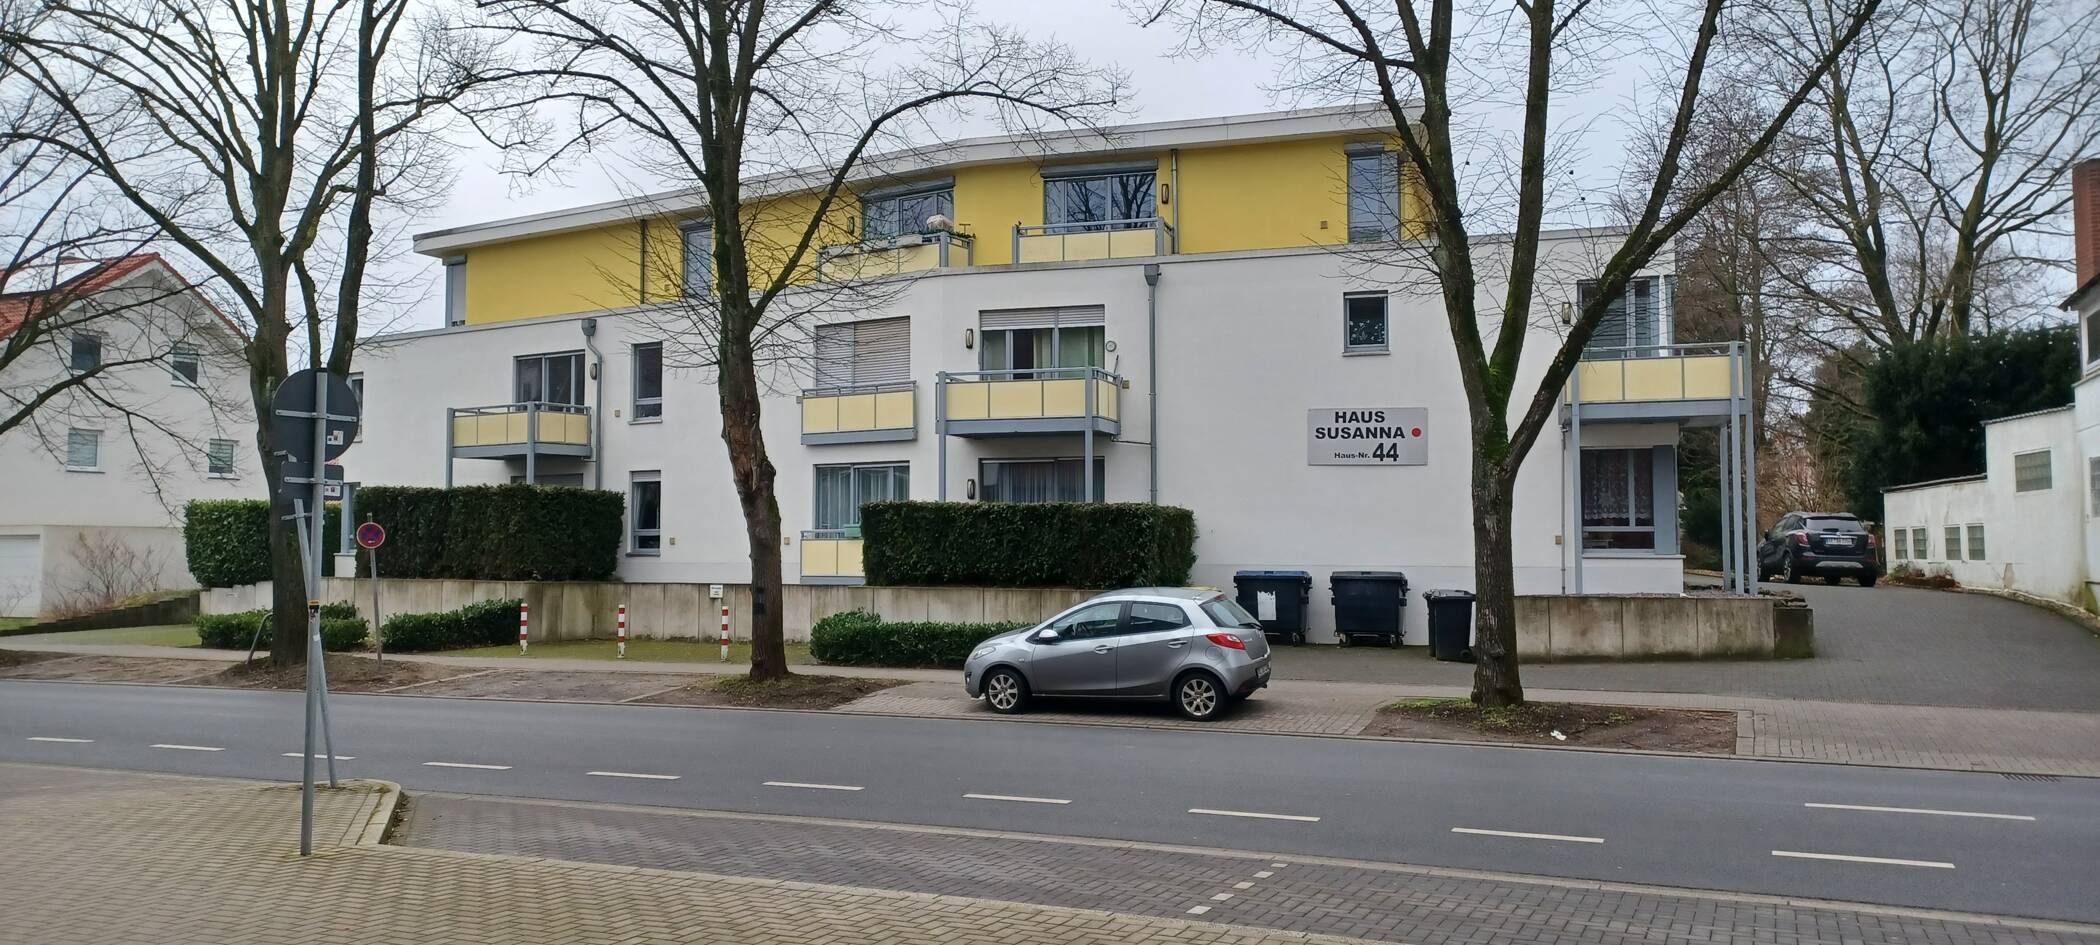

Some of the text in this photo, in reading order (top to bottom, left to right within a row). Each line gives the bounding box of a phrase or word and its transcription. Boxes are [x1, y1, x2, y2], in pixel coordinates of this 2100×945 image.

[1335, 411, 1386, 423] HAUS
[1315, 427, 1405, 439] SUSANNA
[1372, 443, 1399, 461] 44
